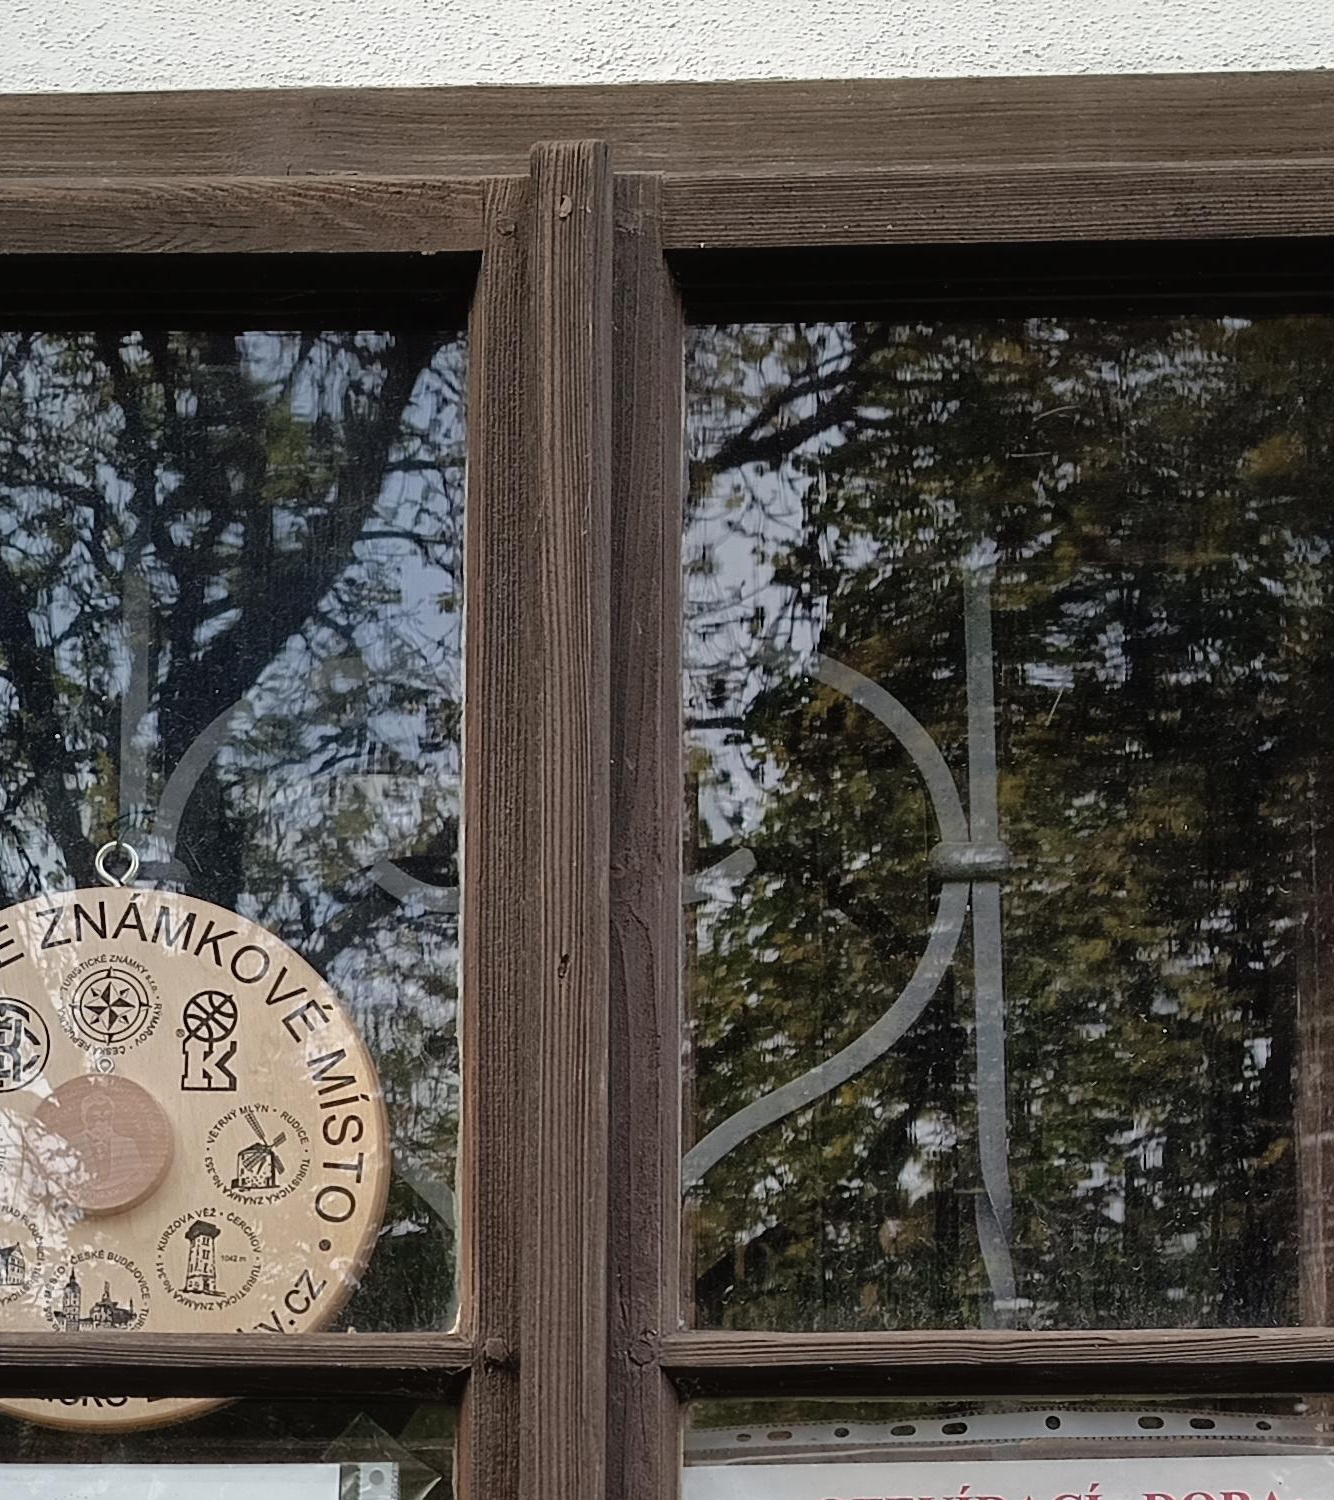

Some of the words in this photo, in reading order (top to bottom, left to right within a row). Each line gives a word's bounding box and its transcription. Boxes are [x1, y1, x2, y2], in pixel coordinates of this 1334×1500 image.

[60, 954, 107, 991] TURISTICKÉ
[109, 955, 149, 974] ZNÁMKY
[35, 894, 338, 1043] ZNÁMKOVÉ
[307, 1047, 365, 1224] MÍSTO
[280, 1111, 309, 1144] RUDICE
[157, 1213, 194, 1252] KURZOVA
[70, 1250, 104, 1265] ČESKÉ
